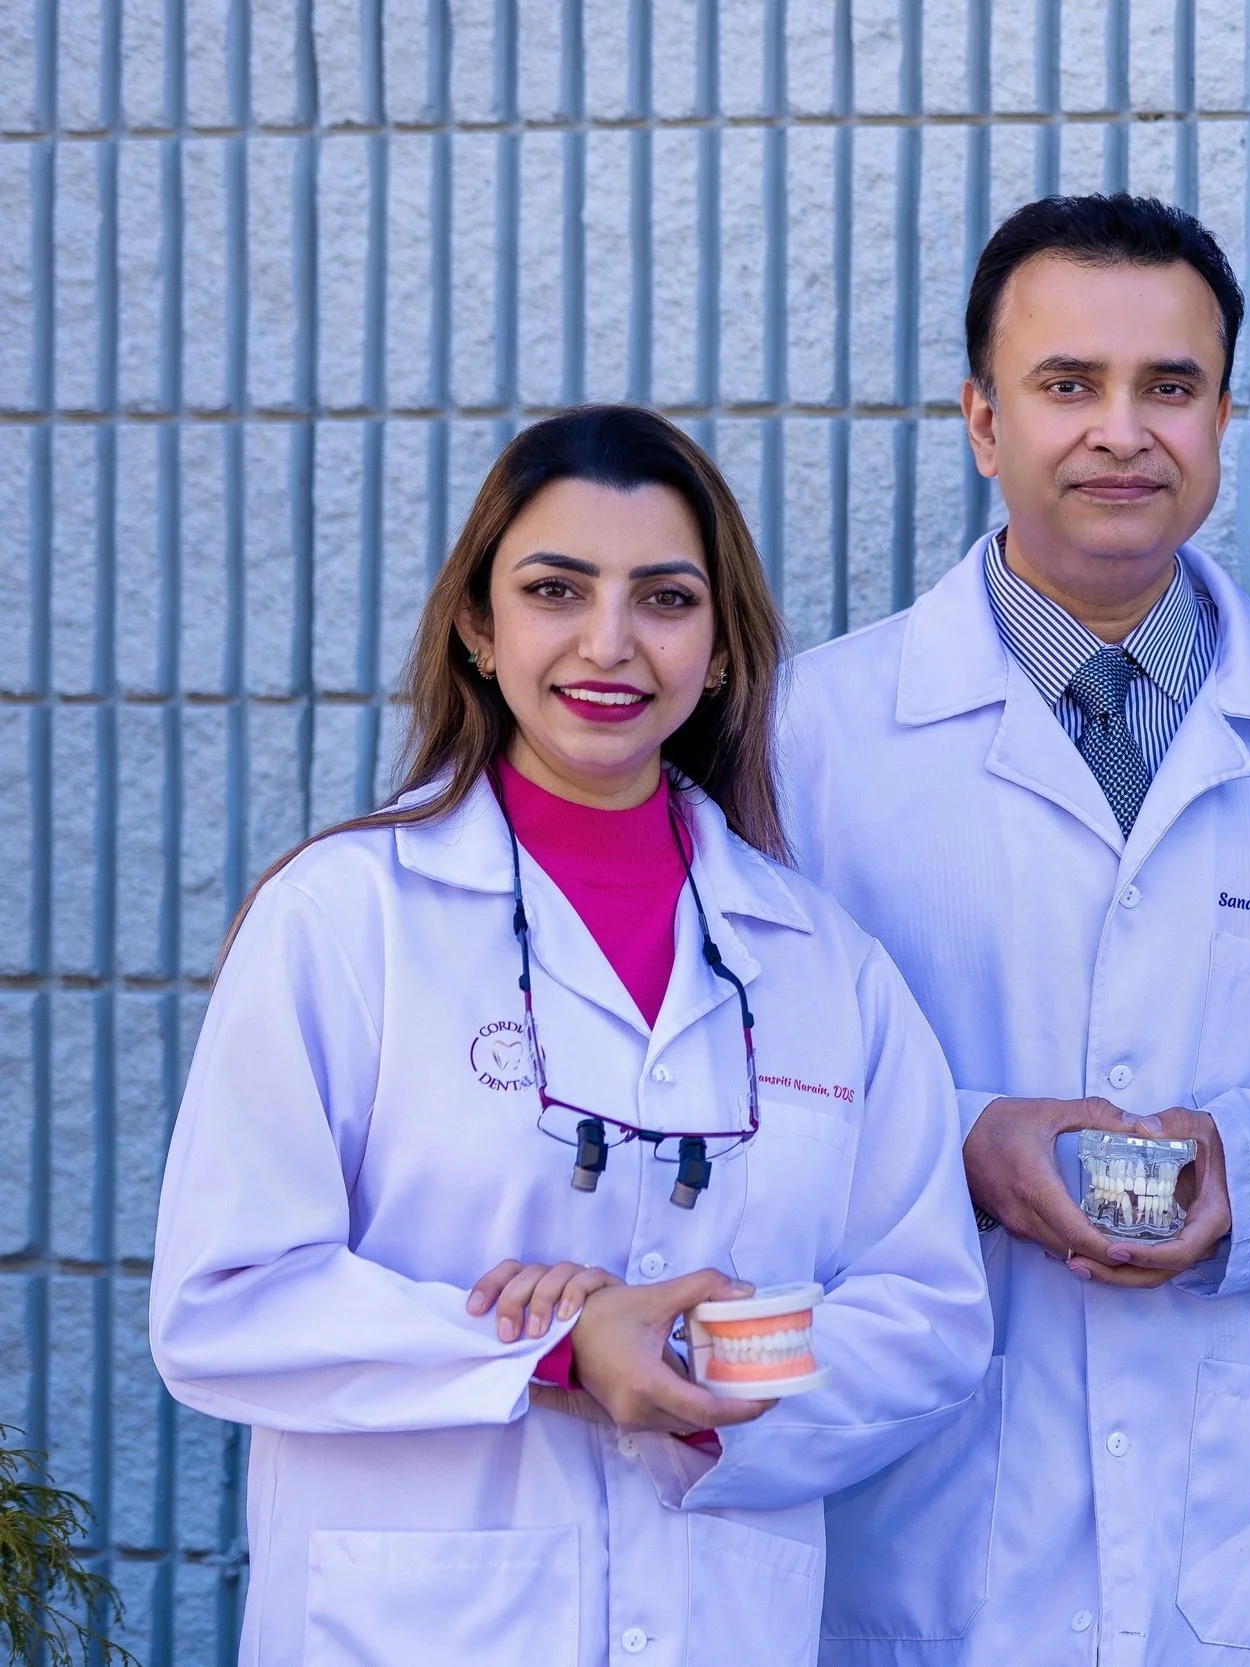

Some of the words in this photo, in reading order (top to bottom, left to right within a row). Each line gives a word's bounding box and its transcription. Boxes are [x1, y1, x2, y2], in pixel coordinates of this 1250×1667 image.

[758, 1074, 792, 1087] ansriti
[793, 1078, 830, 1097] Narain,
[833, 1085, 855, 1103] DDS
